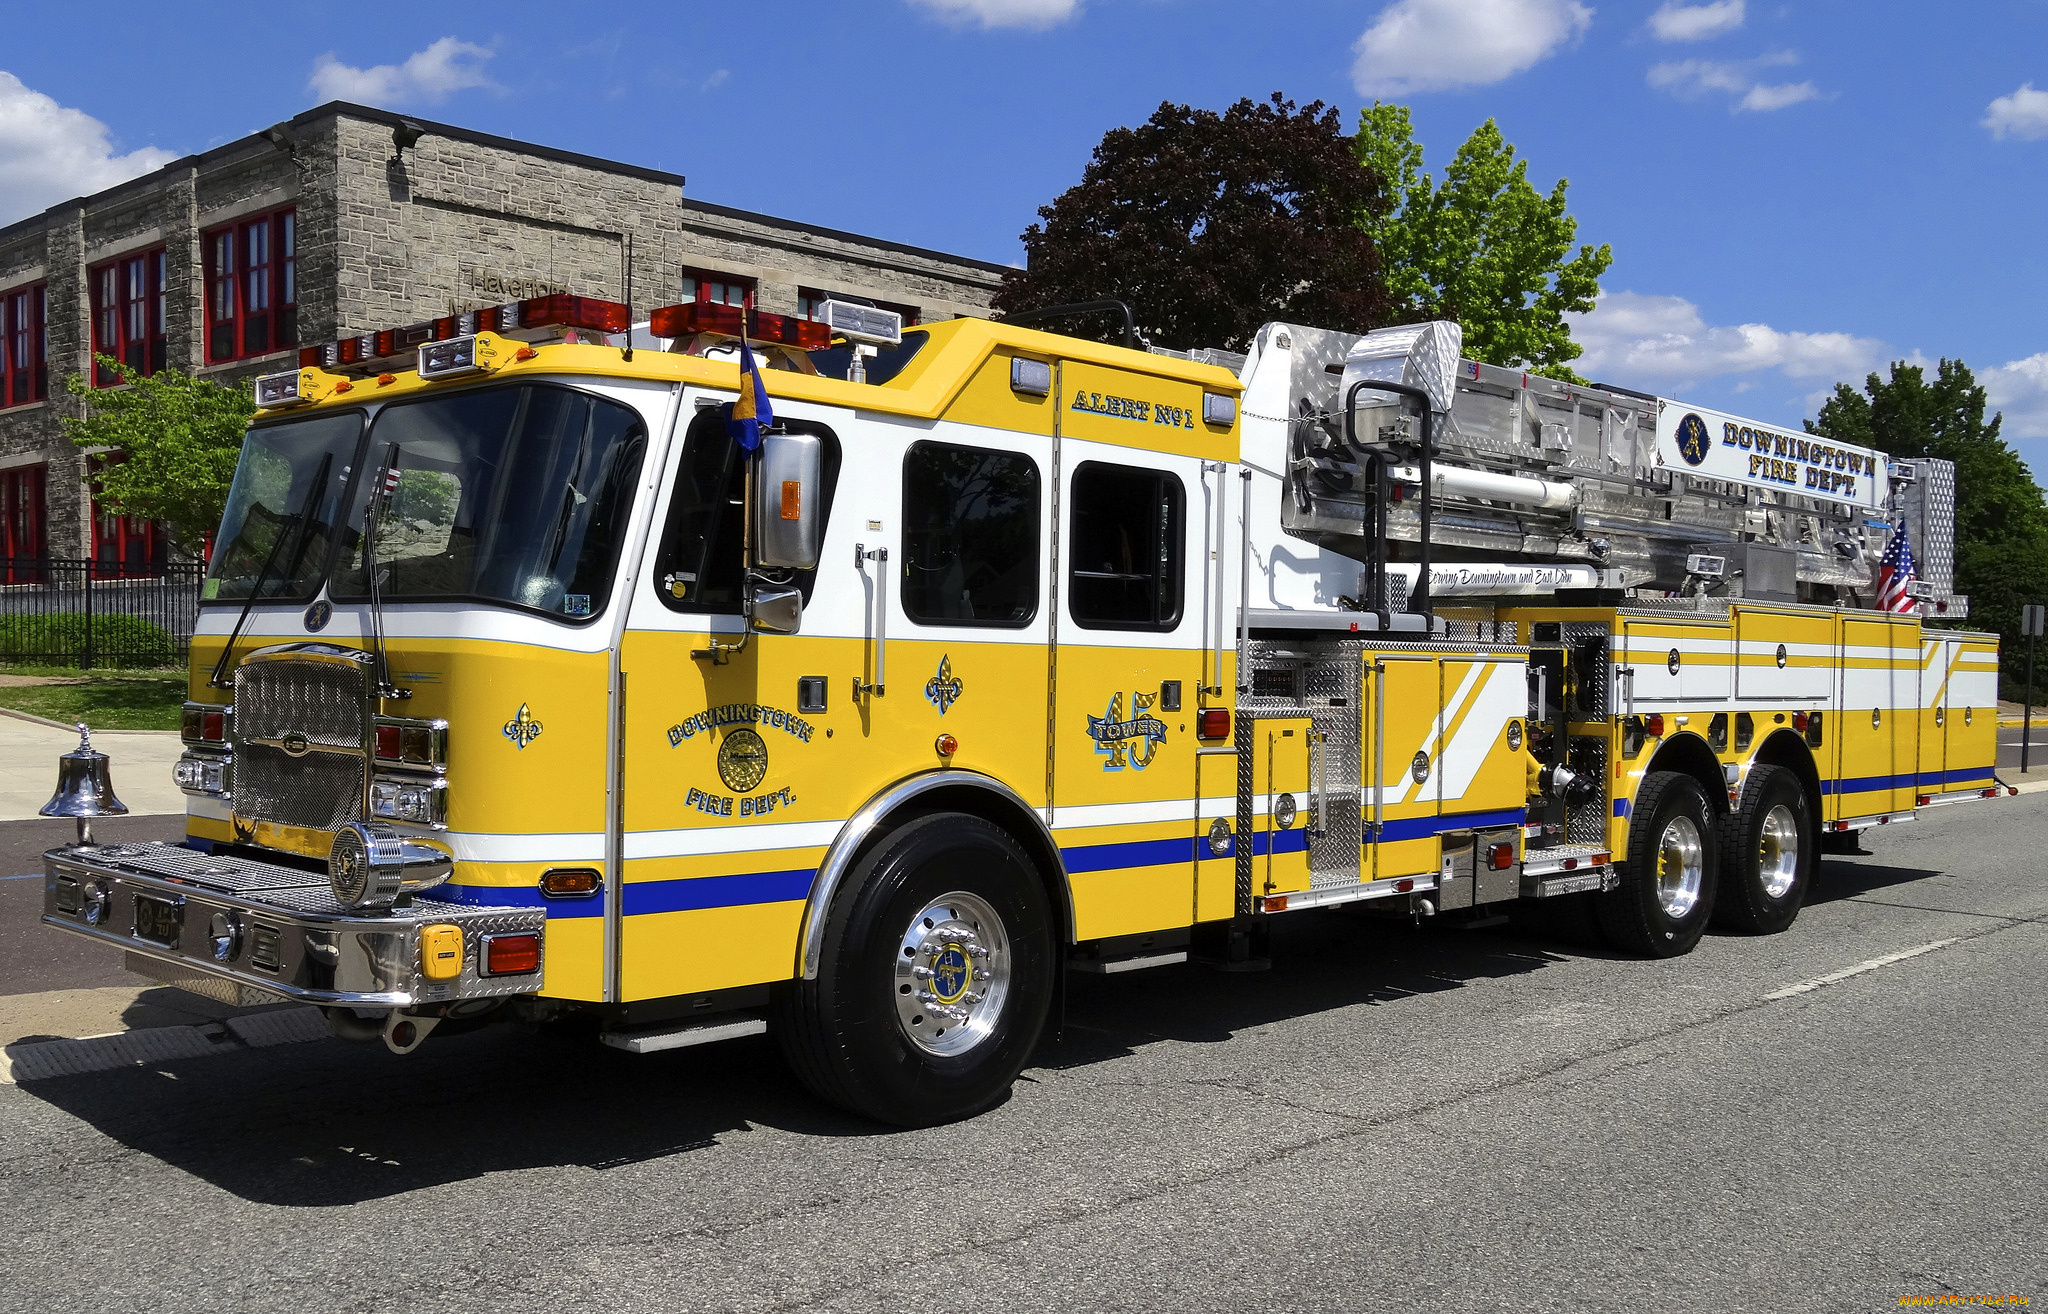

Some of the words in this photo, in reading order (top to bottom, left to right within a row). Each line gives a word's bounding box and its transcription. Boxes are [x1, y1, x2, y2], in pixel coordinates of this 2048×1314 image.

[1071, 390, 1151, 422] ALERT
[1722, 422, 1877, 478] DOWNINGTOWN
[1748, 454, 1798, 485] FIRE
[1805, 467, 1857, 499] DEPT.
[1459, 568, 1516, 589] Downingtown
[1519, 569, 1534, 584] and
[667, 703, 815, 749] DOWNINGTOWN
[1093, 720, 1162, 739] TOWER
[1094, 691, 1158, 772] 45
[684, 787, 734, 818] FIRE
[739, 786, 797, 818] DEPT.
